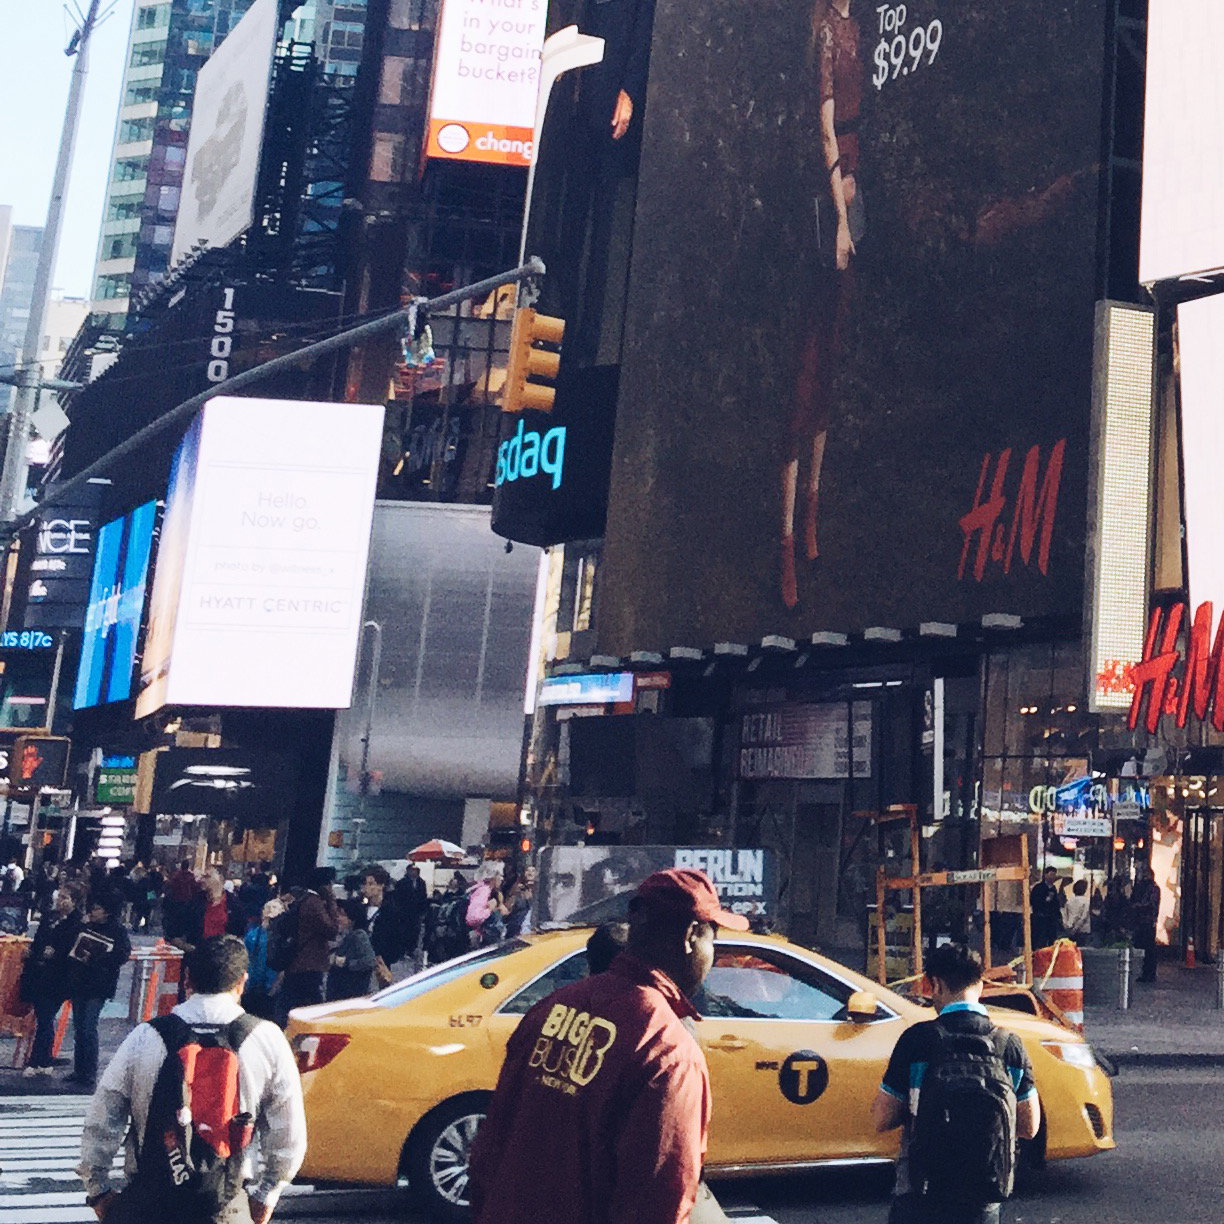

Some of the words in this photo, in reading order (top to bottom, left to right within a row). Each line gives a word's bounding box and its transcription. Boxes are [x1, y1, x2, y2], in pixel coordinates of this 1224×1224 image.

[463, 11, 481, 28] in
[488, 18, 536, 36] your
[460, 34, 542, 61] bargain
[872, 18, 943, 91] $9.99
[457, 60, 538, 84] bucket?
[207, 287, 235, 382] 1500
[257, 492, 308, 510] Hello
[958, 438, 1067, 582] H&M
[241, 511, 286, 528] Now
[199, 596, 257, 610] HYATT
[263, 598, 342, 614] CENTRIC
[674, 849, 764, 883] BERLIN
[541, 1003, 590, 1046] BIG
[791, 1060, 818, 1097] T
